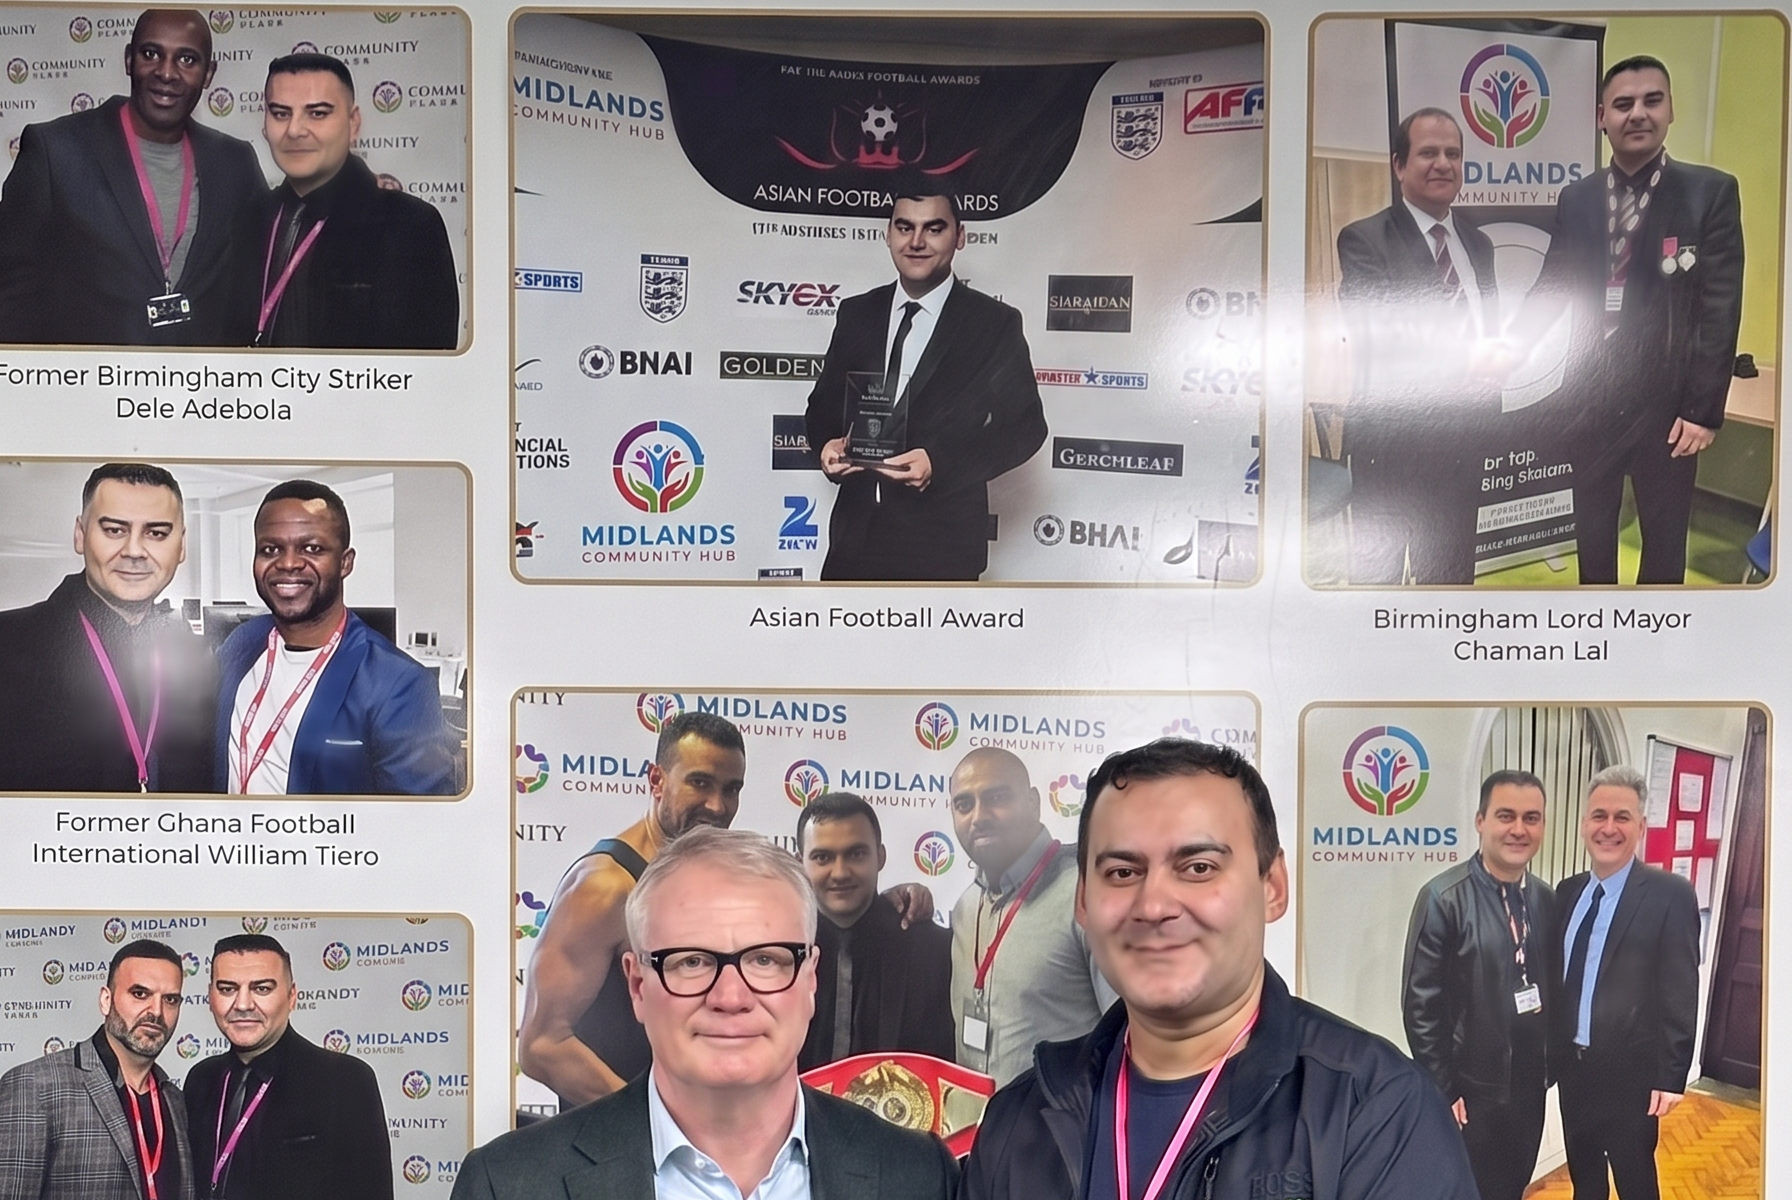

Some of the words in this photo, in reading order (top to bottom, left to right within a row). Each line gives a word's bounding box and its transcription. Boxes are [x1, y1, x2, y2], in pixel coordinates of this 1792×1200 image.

[324, 40, 419, 56] COMMUNITY
[32, 58, 106, 71] COMMUNITY
[867, 72, 927, 85] FOOTBALL
[930, 75, 981, 86] AWARDS
[513, 76, 665, 122] MIDLANDS
[629, 125, 665, 141] HUB
[1463, 161, 1583, 185] DLANDS
[753, 184, 812, 203] ASIAN
[817, 187, 897, 208] FOOTBA
[619, 350, 693, 376] BNAI
[723, 356, 825, 377] GOLDEN
[98, 364, 263, 393] Birmingham
[271, 366, 321, 394] City
[328, 367, 413, 390] Striker
[117, 396, 175, 419] Dele
[181, 397, 291, 421] Adebola
[517, 454, 570, 469] TIONS
[582, 525, 736, 547] MIDLANDS
[582, 551, 691, 564] COMMUNITY
[699, 550, 736, 562] HUB
[749, 606, 819, 628] Asian
[829, 607, 932, 628] Football
[940, 607, 1024, 628] Award
[1374, 607, 1538, 634] Birmingham
[1548, 608, 1603, 629] Lord
[1613, 608, 1692, 634] Mayor
[1454, 639, 1564, 661] Chaman
[1574, 639, 1608, 661] Lal
[697, 695, 848, 724] MIDLANDS
[812, 728, 848, 741] HUB
[970, 712, 1107, 739] MIDLANDS
[968, 736, 1066, 752] COMMUNITY
[1073, 743, 1106, 755] HUB
[562, 779, 647, 795] COMMUN
[840, 769, 952, 794] MIDLAN
[57, 811, 151, 833] Former
[157, 812, 242, 833] Ghana
[251, 813, 355, 834] Football
[1313, 826, 1458, 846] MIDLANDS
[34, 843, 199, 865] International
[207, 844, 307, 866] William
[314, 845, 379, 866] Tiero
[1312, 851, 1416, 862] COMMUNITY
[1424, 851, 1458, 862] HUB
[356, 940, 450, 958] MIDLANDS
[356, 1031, 450, 1046] MIDLANDS
